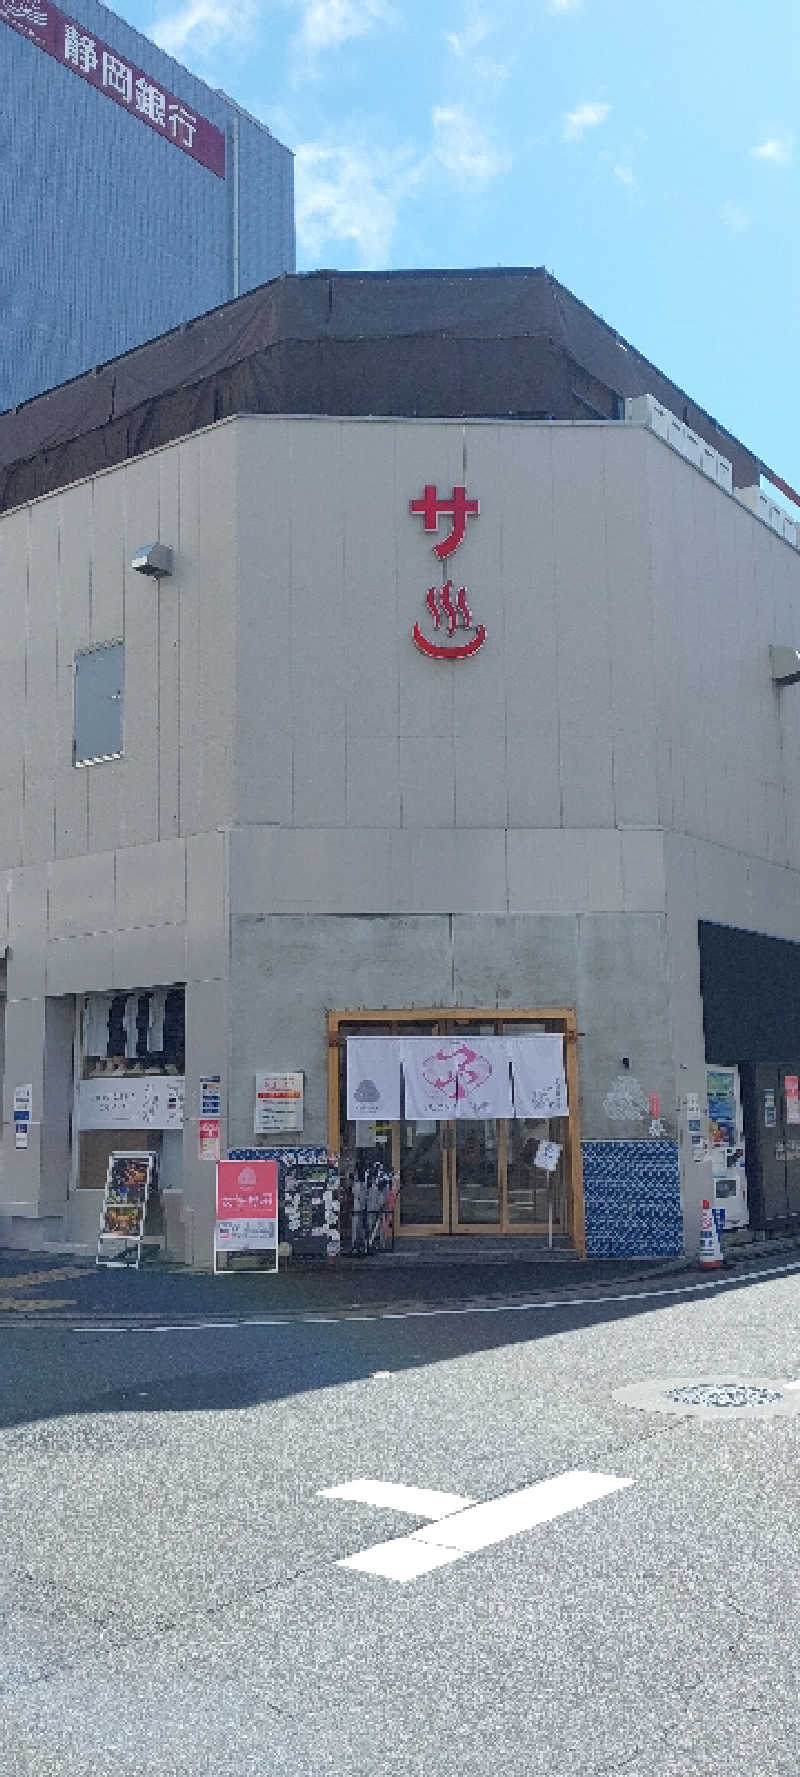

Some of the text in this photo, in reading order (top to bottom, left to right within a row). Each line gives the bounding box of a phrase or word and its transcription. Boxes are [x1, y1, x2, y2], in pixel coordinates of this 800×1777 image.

[64, 24, 197, 148] 静岡銀行
[409, 484, 481, 559] サ
